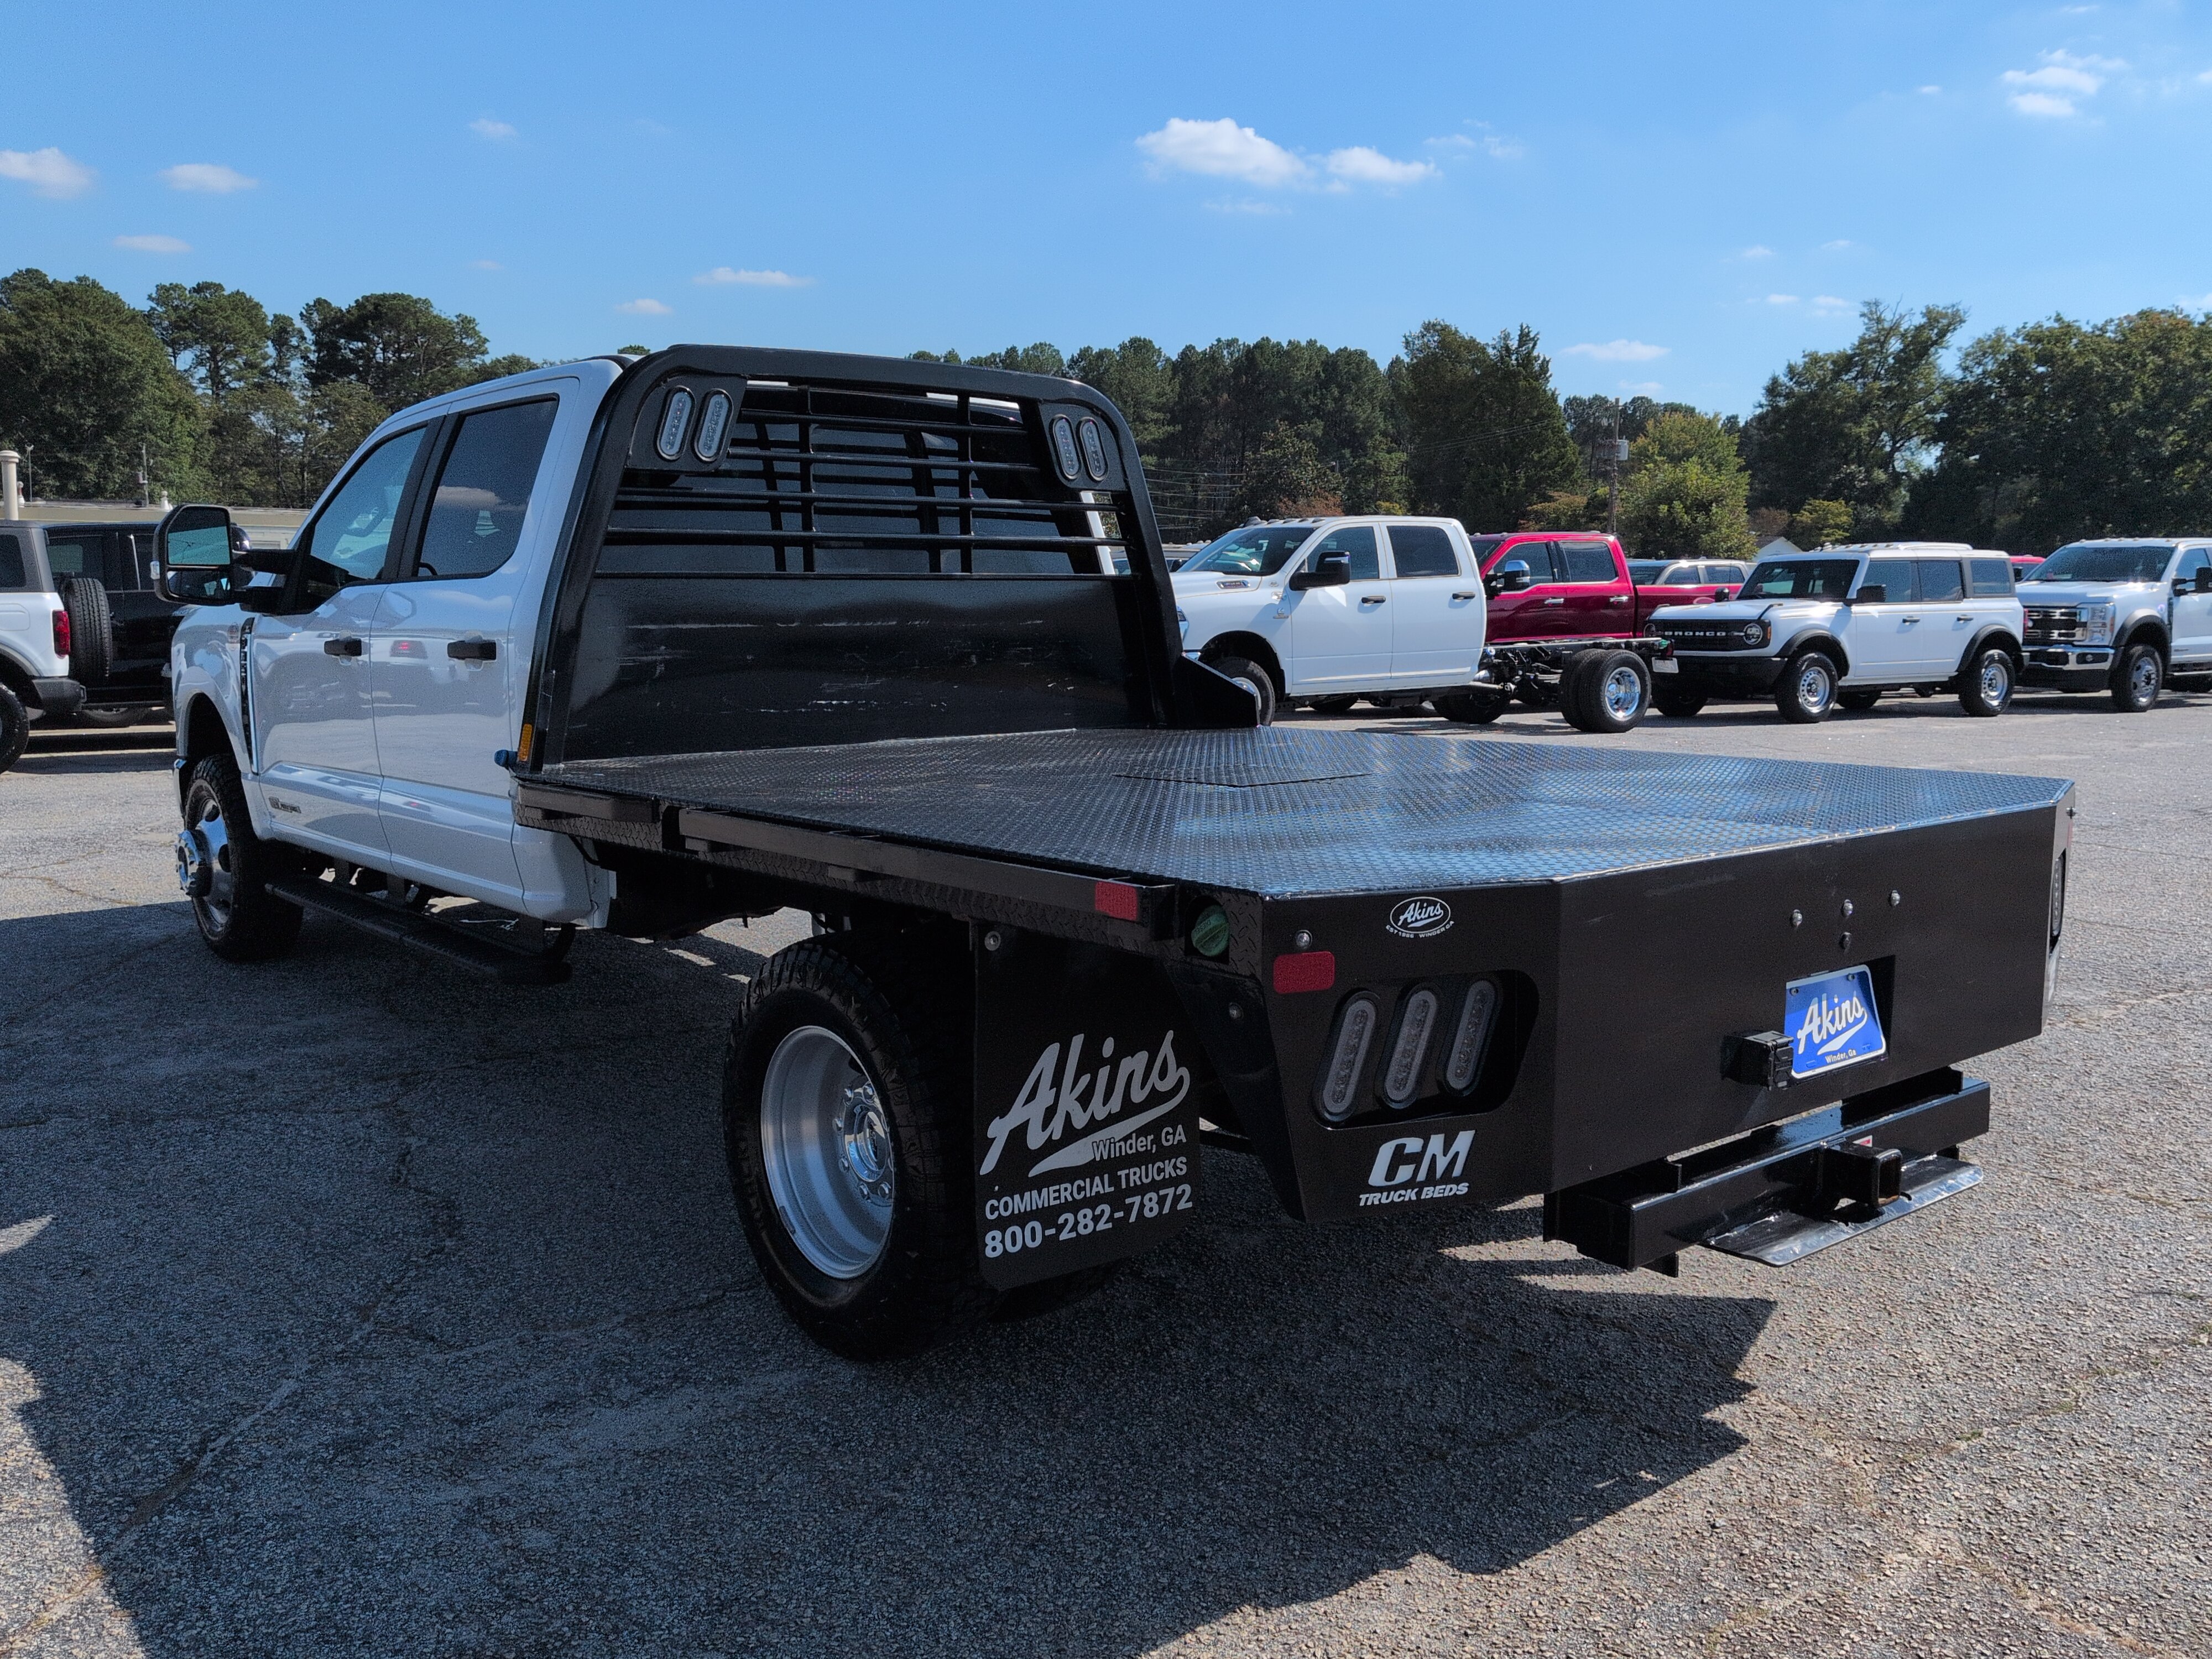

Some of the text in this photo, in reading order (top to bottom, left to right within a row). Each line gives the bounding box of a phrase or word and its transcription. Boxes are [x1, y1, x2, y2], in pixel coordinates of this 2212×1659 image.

[1385, 924, 1399, 935] EST
[1419, 928, 1446, 938] WINDER
[1446, 920, 1455, 930] GA
[1397, 901, 1444, 927] Akins
[1797, 991, 1868, 1055] Akins
[1825, 1052, 1848, 1063] Winder,
[980, 1030, 1190, 1177] Akins
[1092, 1124, 1187, 1161] Winder, GA
[1368, 1130, 1476, 1187] CM
[985, 1156, 1187, 1220] COMMERCIAL TRUCKS
[1359, 1182, 1469, 1206] TRUCK BEDS
[985, 1183, 1193, 1258] 800-282-7872
